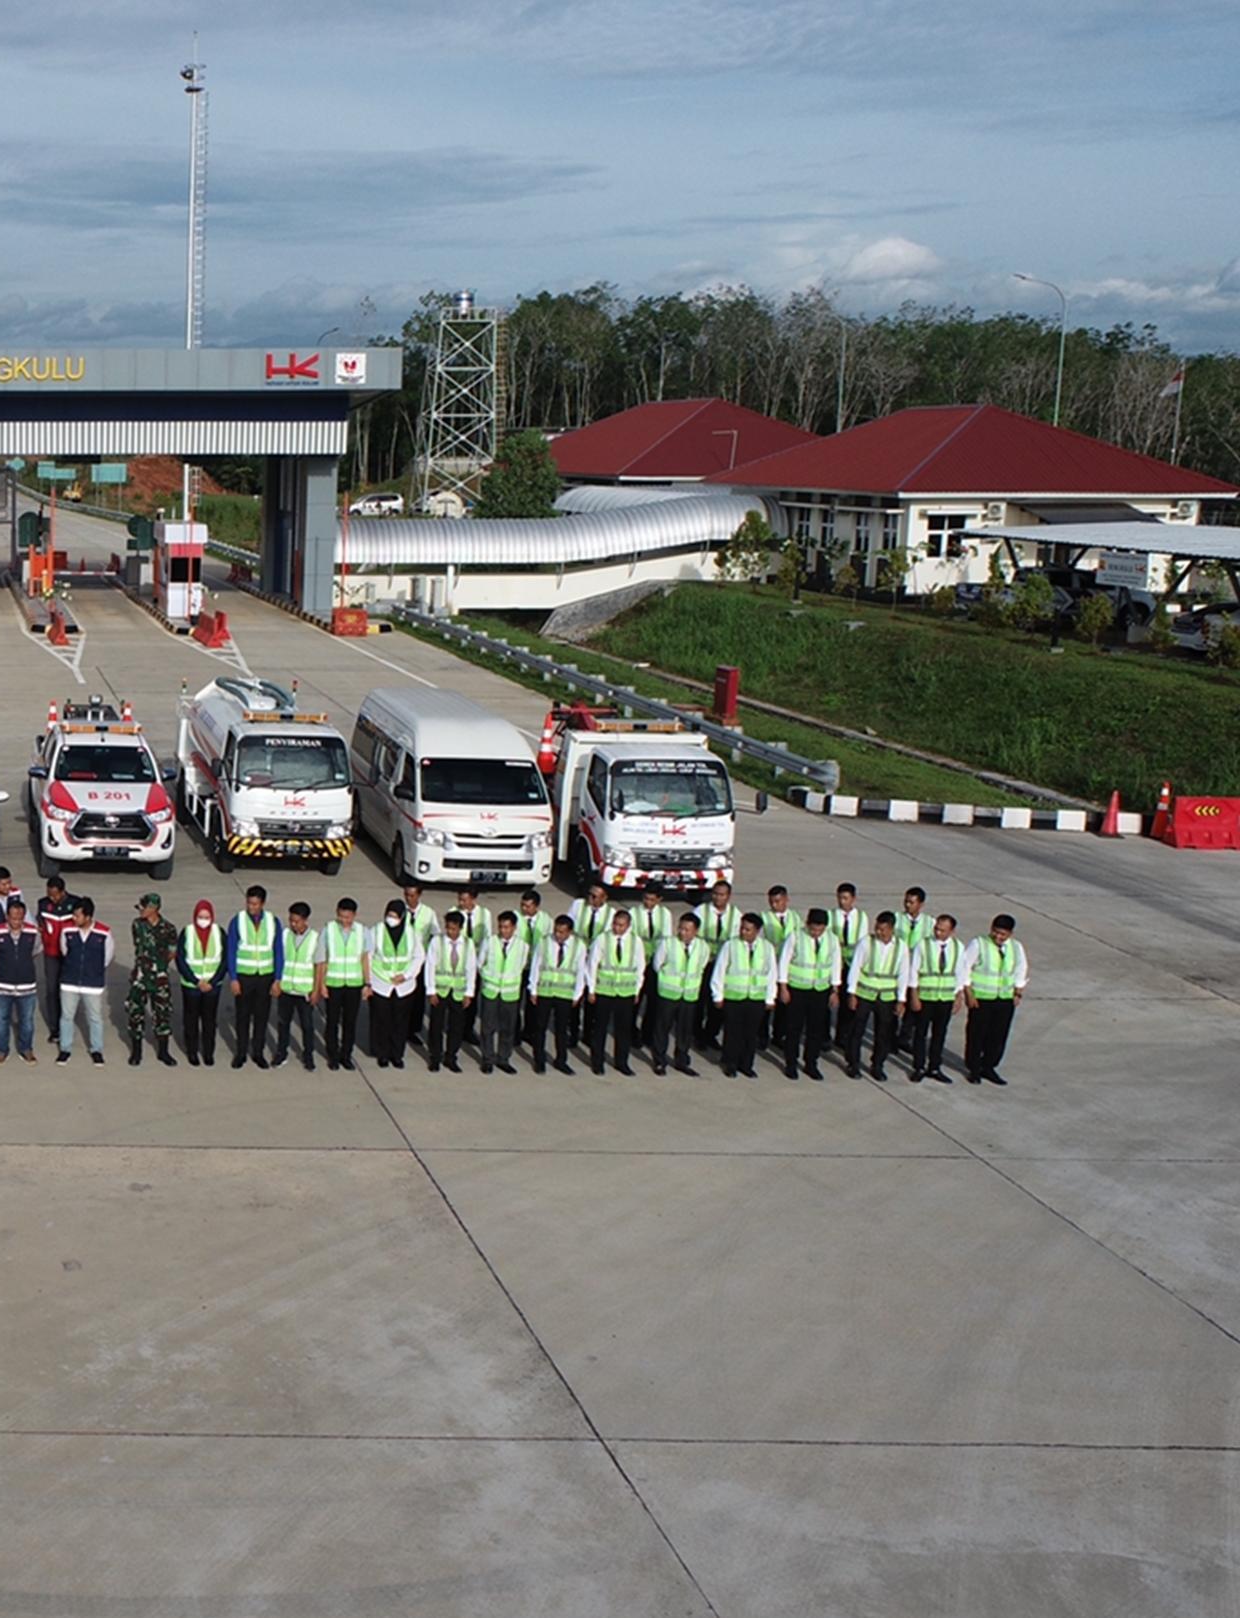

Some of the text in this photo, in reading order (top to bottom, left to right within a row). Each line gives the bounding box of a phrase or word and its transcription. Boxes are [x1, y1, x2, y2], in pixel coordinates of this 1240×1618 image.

[265, 352, 320, 379] HK
[265, 737, 322, 748] PENYIRAMAN
[87, 791, 99, 800] B
